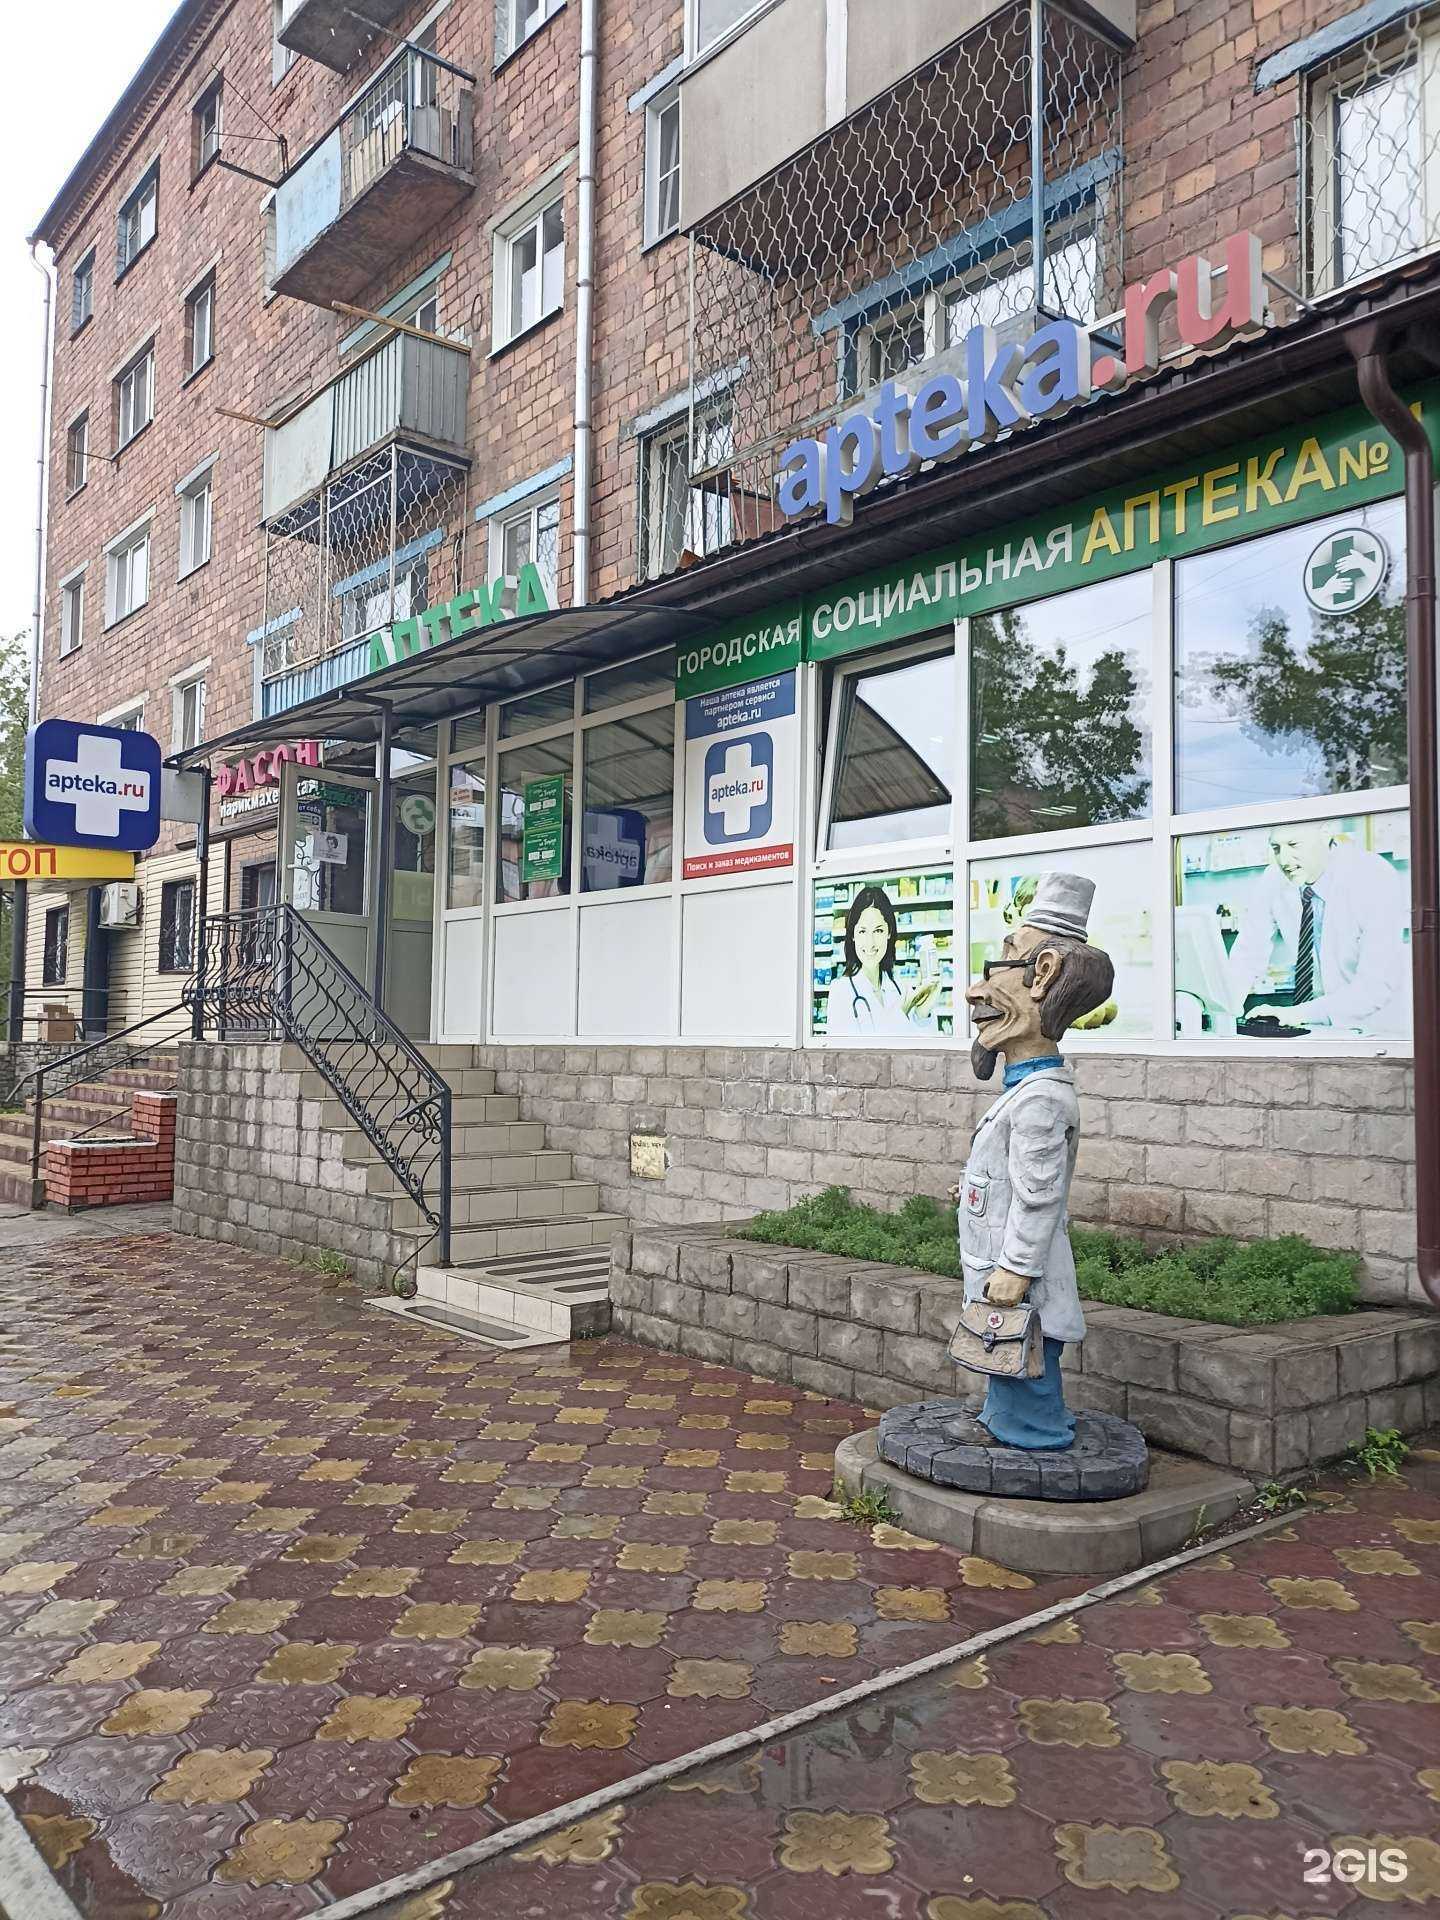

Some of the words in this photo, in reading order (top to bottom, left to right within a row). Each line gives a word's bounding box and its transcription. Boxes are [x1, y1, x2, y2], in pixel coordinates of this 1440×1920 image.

[779, 230, 1262, 527] apteka.ru
[677, 618, 800, 678] ГОРОДСКАЯ
[812, 523, 1073, 639] СОЦИАЛЬНАЯ
[1080, 437, 1337, 565] АПТЕКА
[369, 562, 558, 673] АПТЕКА
[700, 697, 720, 708] Наша
[721, 689, 745, 702] аптека
[746, 679, 781, 695] является
[704, 700, 744, 717] партнером
[744, 691, 776, 706] сервиса
[717, 708, 762, 730] apteka.ru
[216, 741, 319, 797] ФАСОН
[48, 774, 144, 797] apteka.ru
[711, 779, 764, 802] apteka.ru
[687, 862, 708, 872] Поиск
[714, 858, 733, 869] заказ
[734, 851, 790, 867] медикаментов
